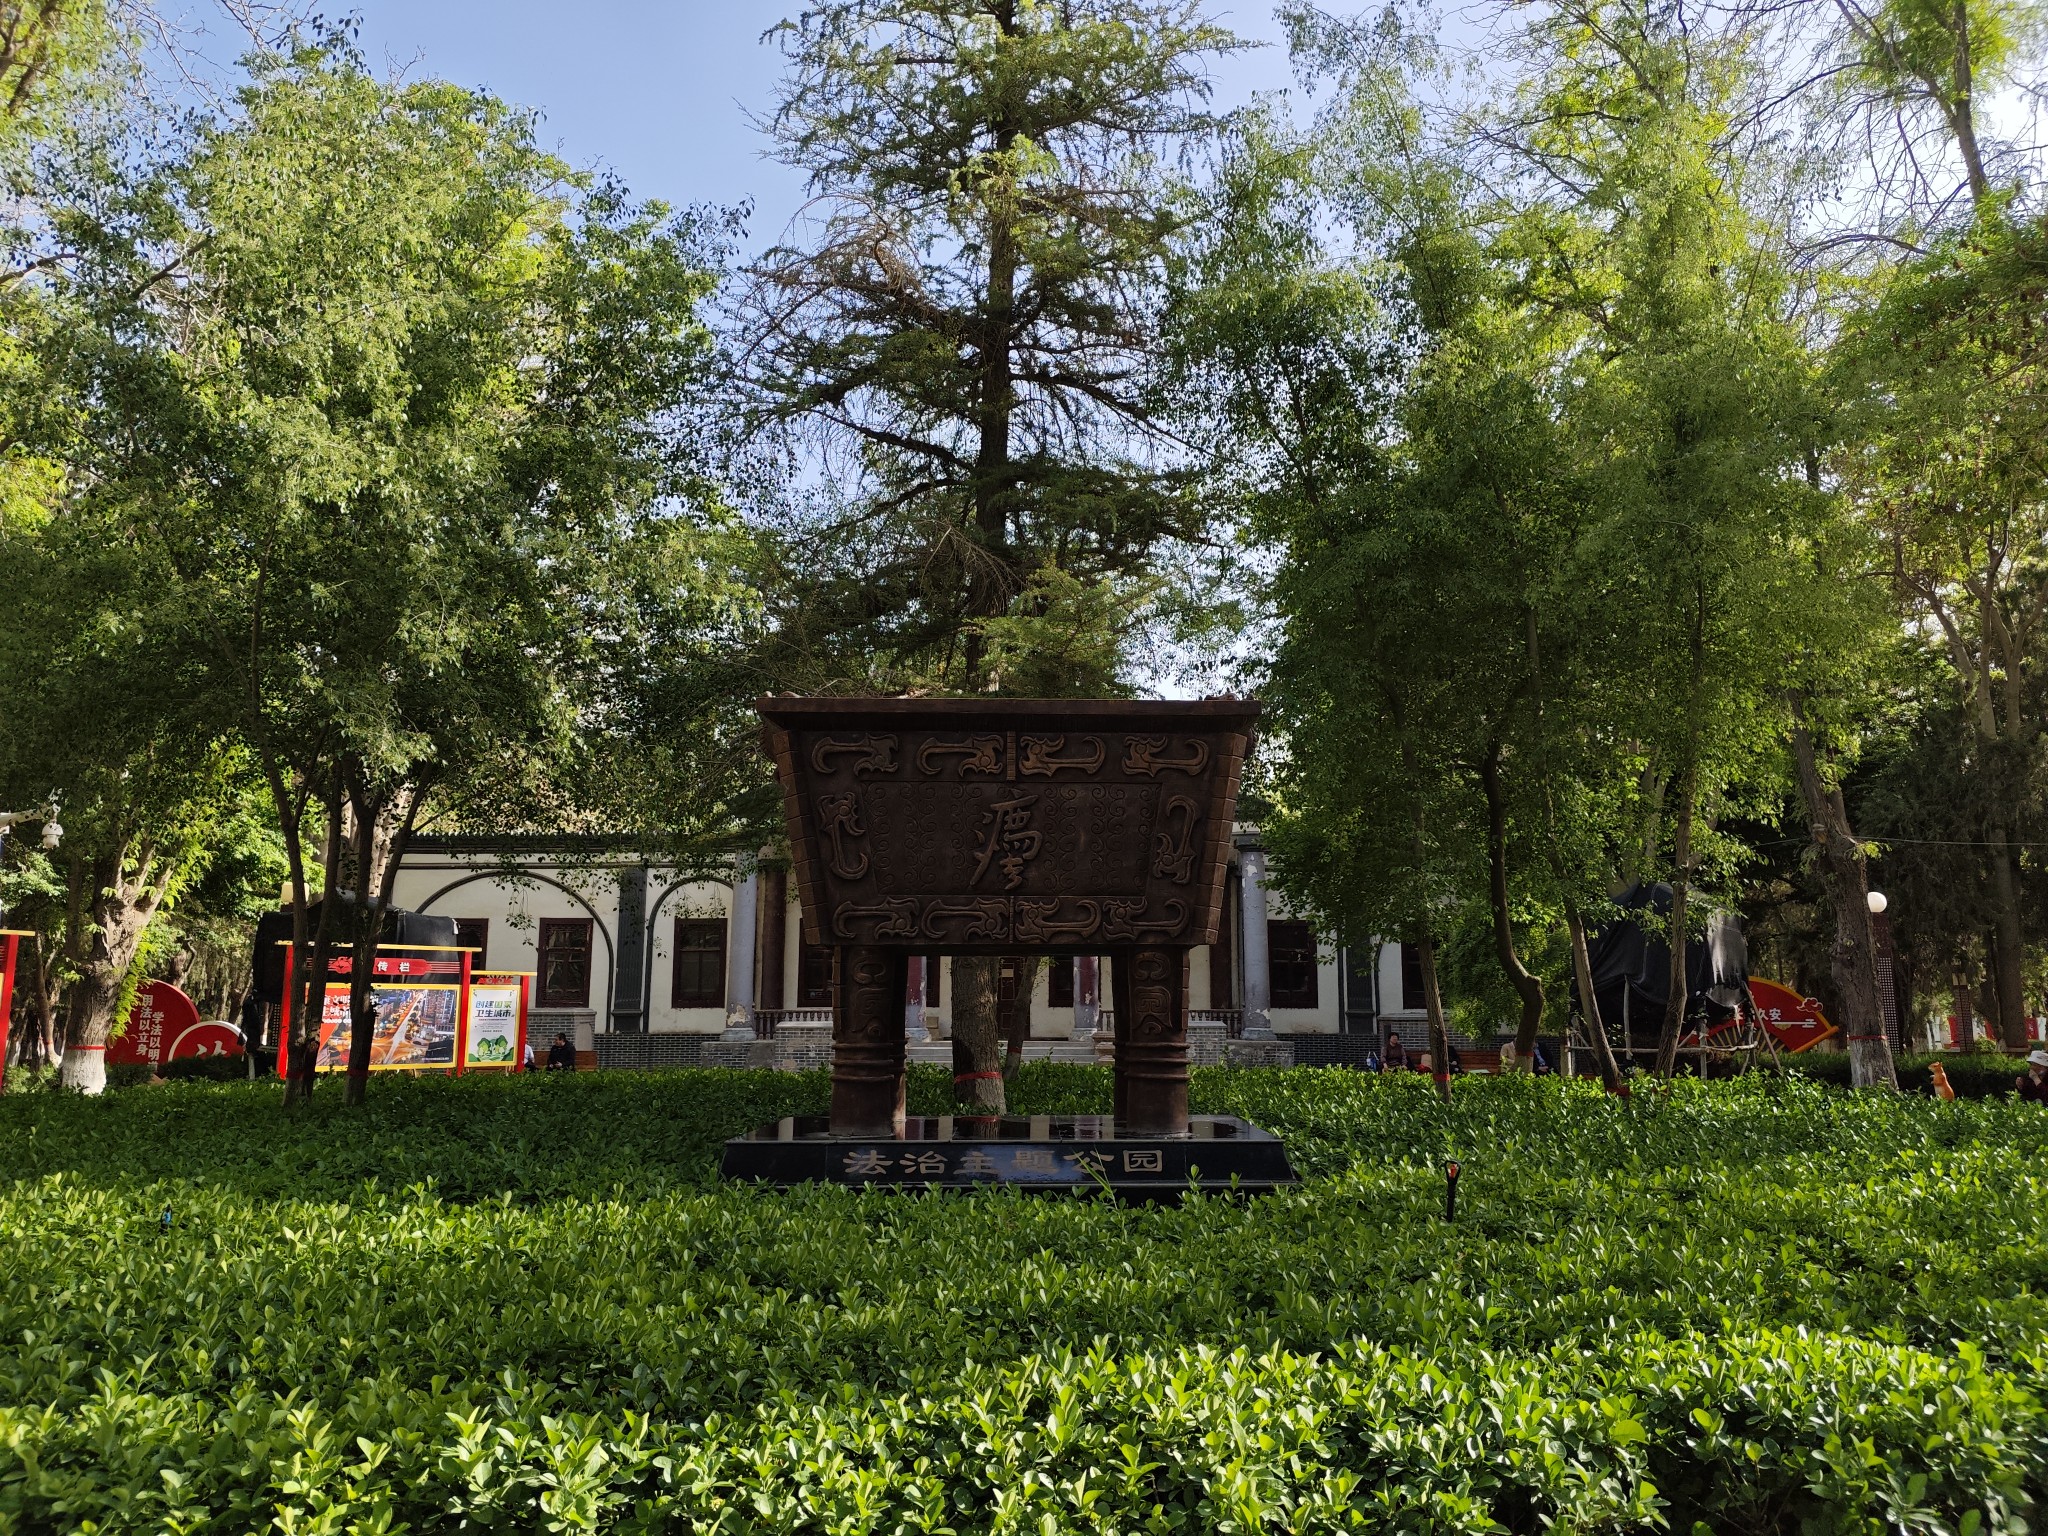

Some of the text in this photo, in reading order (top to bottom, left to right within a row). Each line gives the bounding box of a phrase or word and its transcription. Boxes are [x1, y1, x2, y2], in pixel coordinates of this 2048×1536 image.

[475, 1000, 513, 1009] 创建国家
[475, 1009, 512, 1018] 卫生城市
[136, 994, 153, 1056] 用法以立身
[842, 1149, 1164, 1176] 法治主题公园
